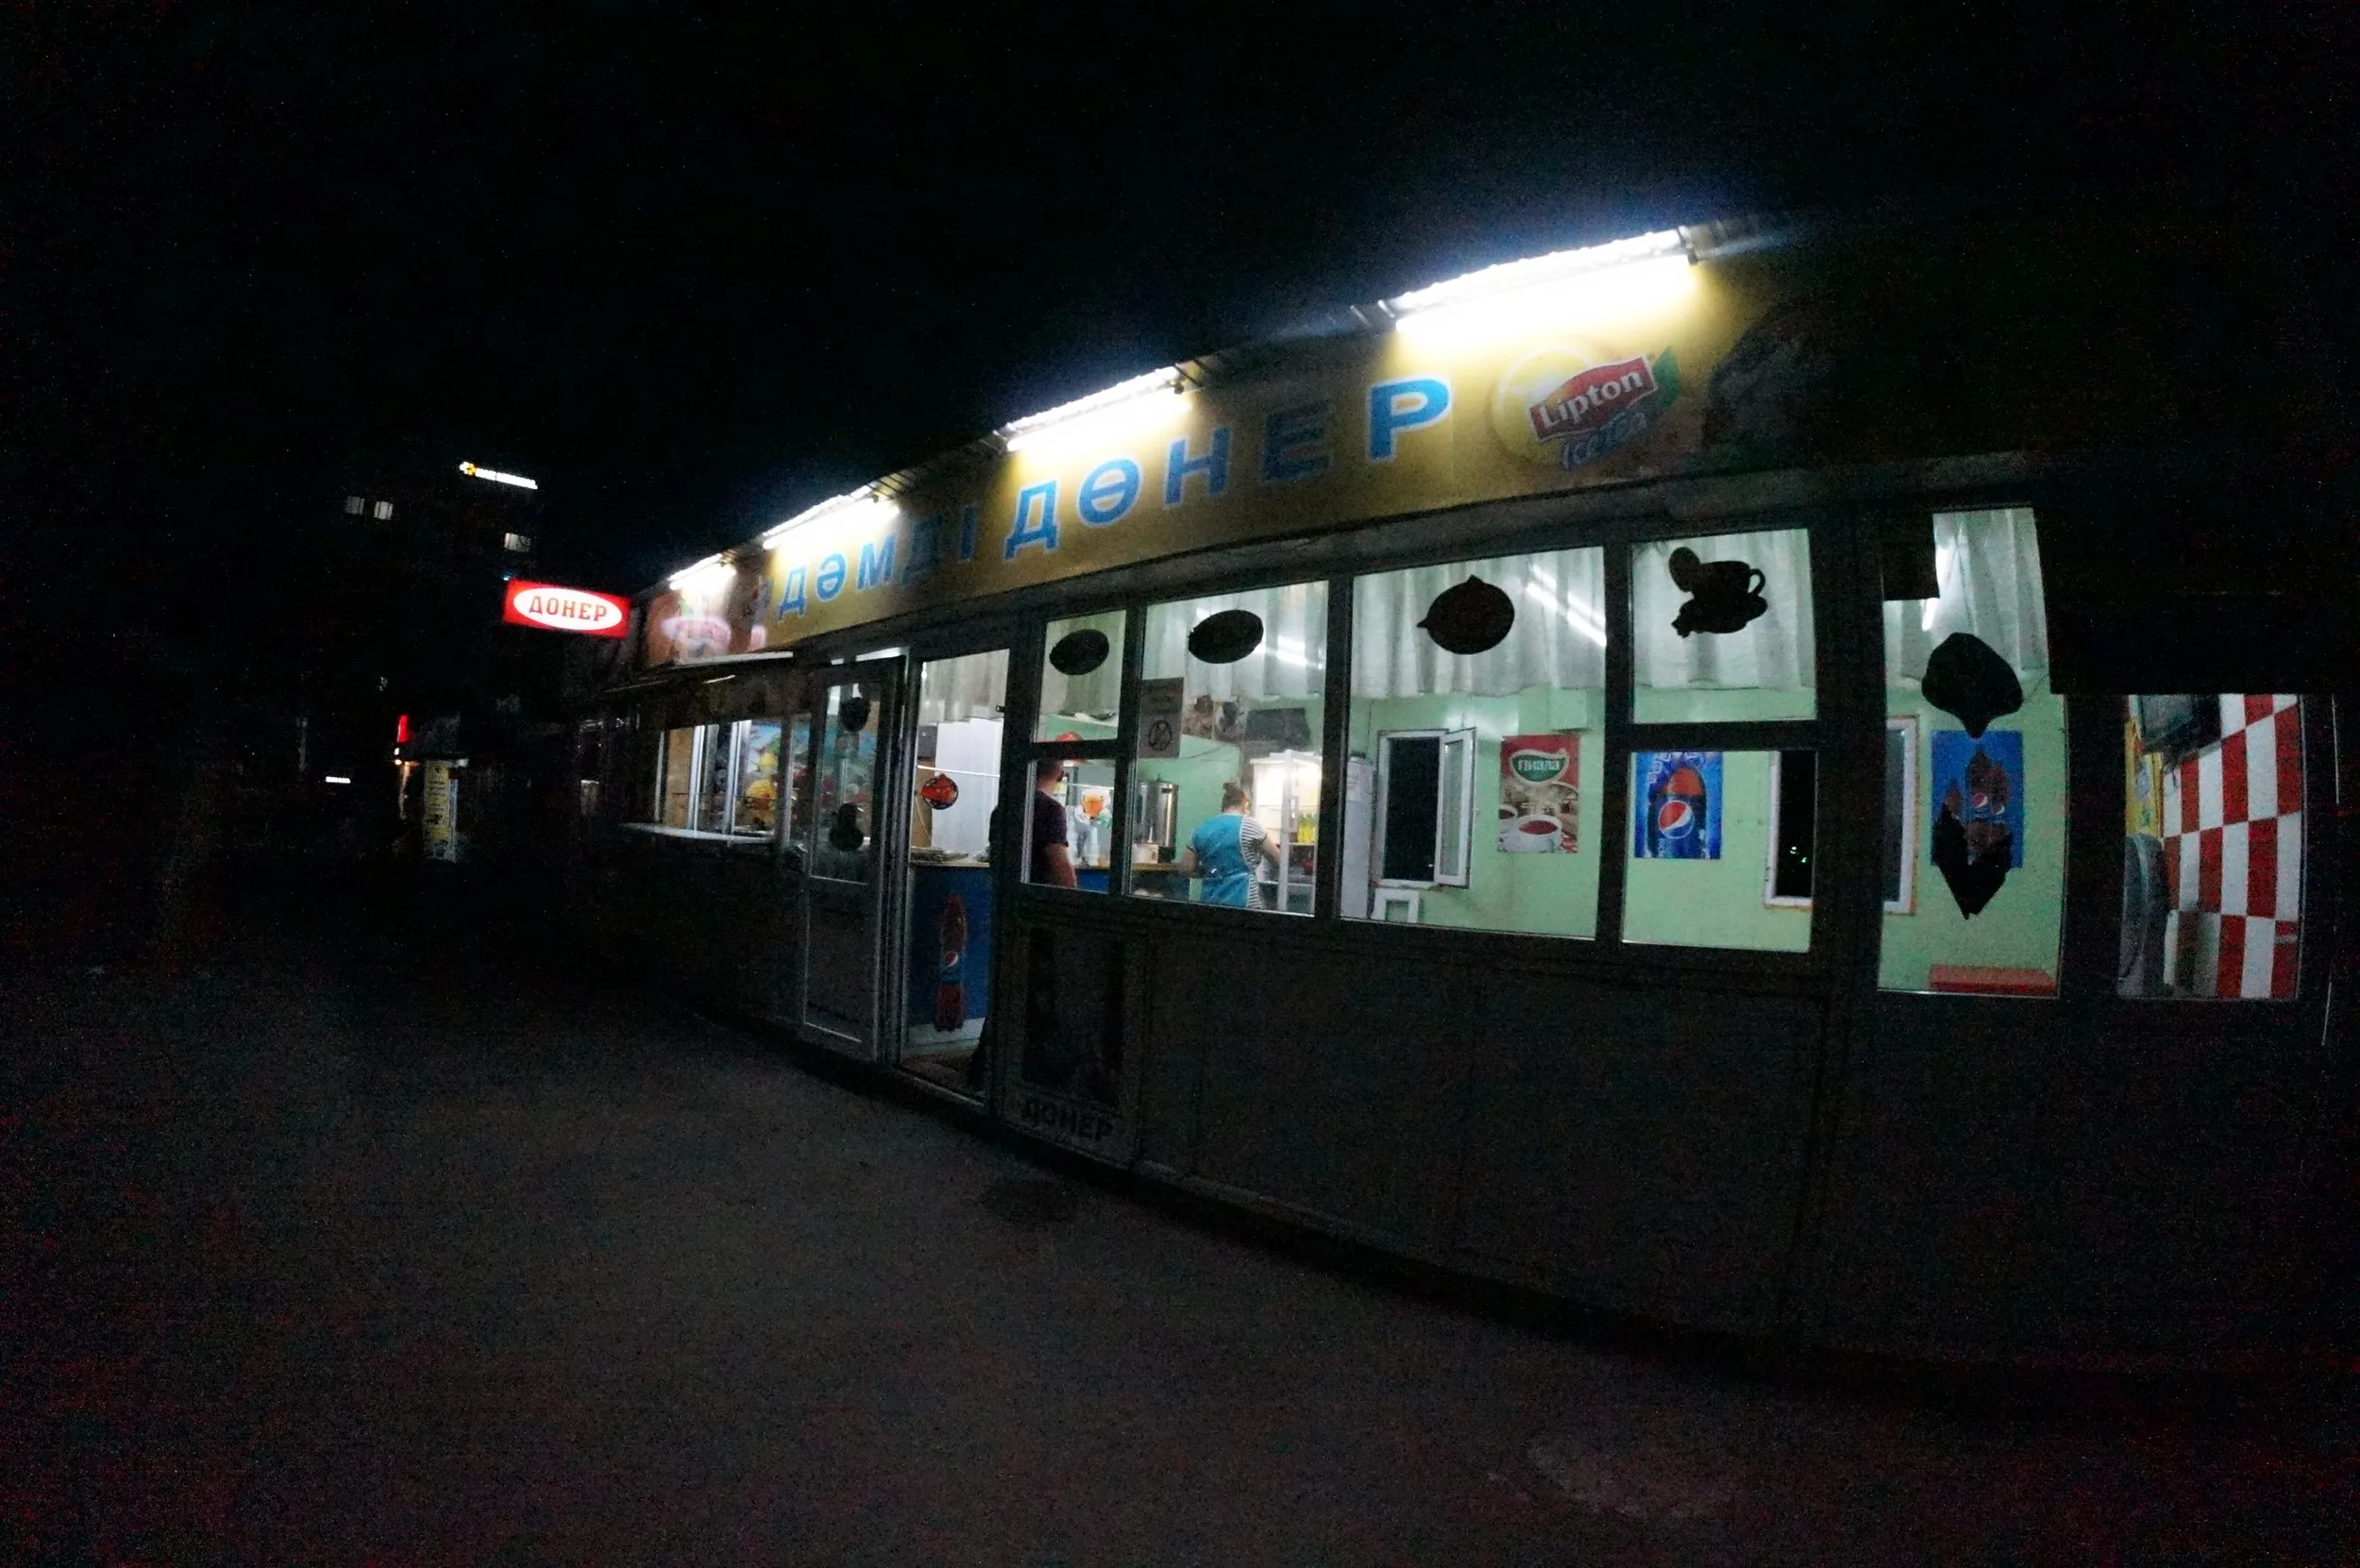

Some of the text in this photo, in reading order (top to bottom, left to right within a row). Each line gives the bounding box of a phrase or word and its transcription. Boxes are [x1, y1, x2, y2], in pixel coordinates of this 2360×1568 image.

[1538, 371, 1644, 428] Lipton
[776, 377, 1452, 619] ДӘМДІ ДӨНЕР
[529, 595, 607, 621] ДОНЕР
